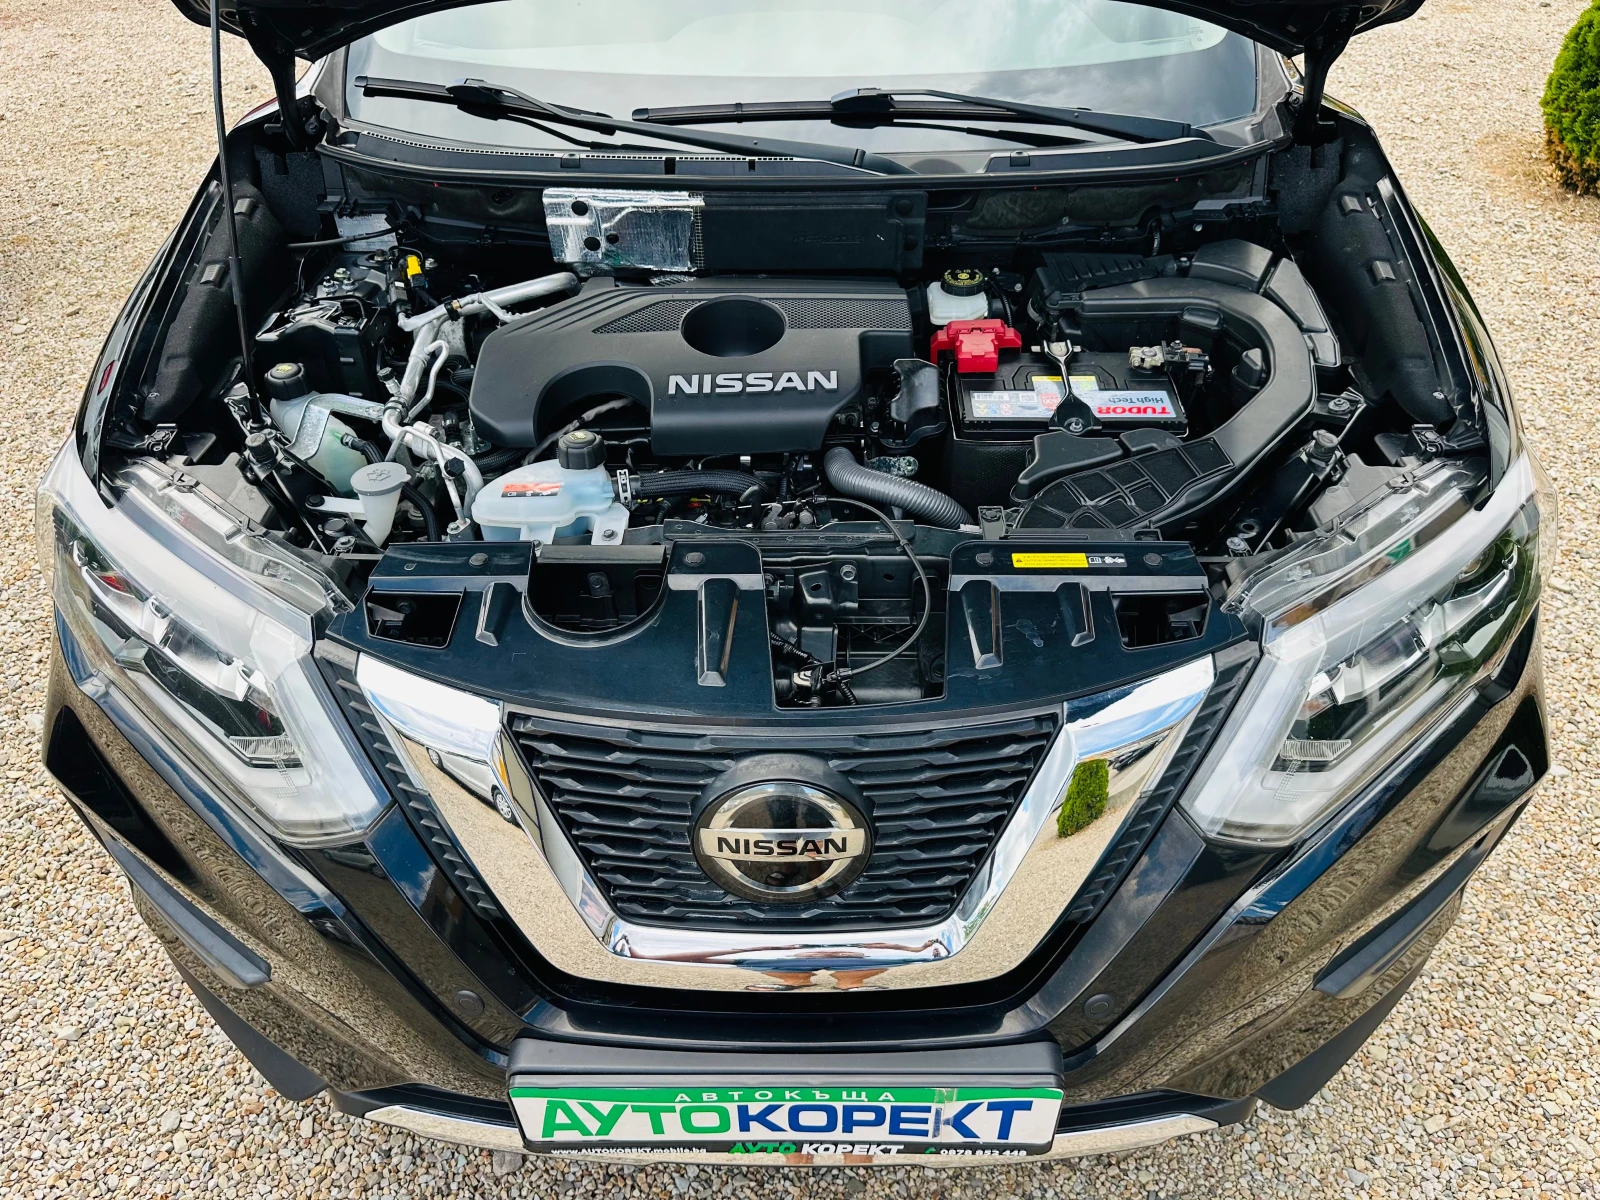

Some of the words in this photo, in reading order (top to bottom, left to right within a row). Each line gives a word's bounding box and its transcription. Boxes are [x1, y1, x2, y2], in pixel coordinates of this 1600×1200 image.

[667, 370, 838, 394] NISSAN
[1135, 395, 1164, 404] High
[1096, 406, 1171, 415] TUDOR
[717, 836, 847, 856] NISSAN
[674, 1090, 896, 1103] АВТОКЪЩА
[541, 1099, 1034, 1141] АУТОКОРЕКТ
[729, 1142, 797, 1155] АУТО
[801, 1143, 904, 1155] КОРЕКТ
